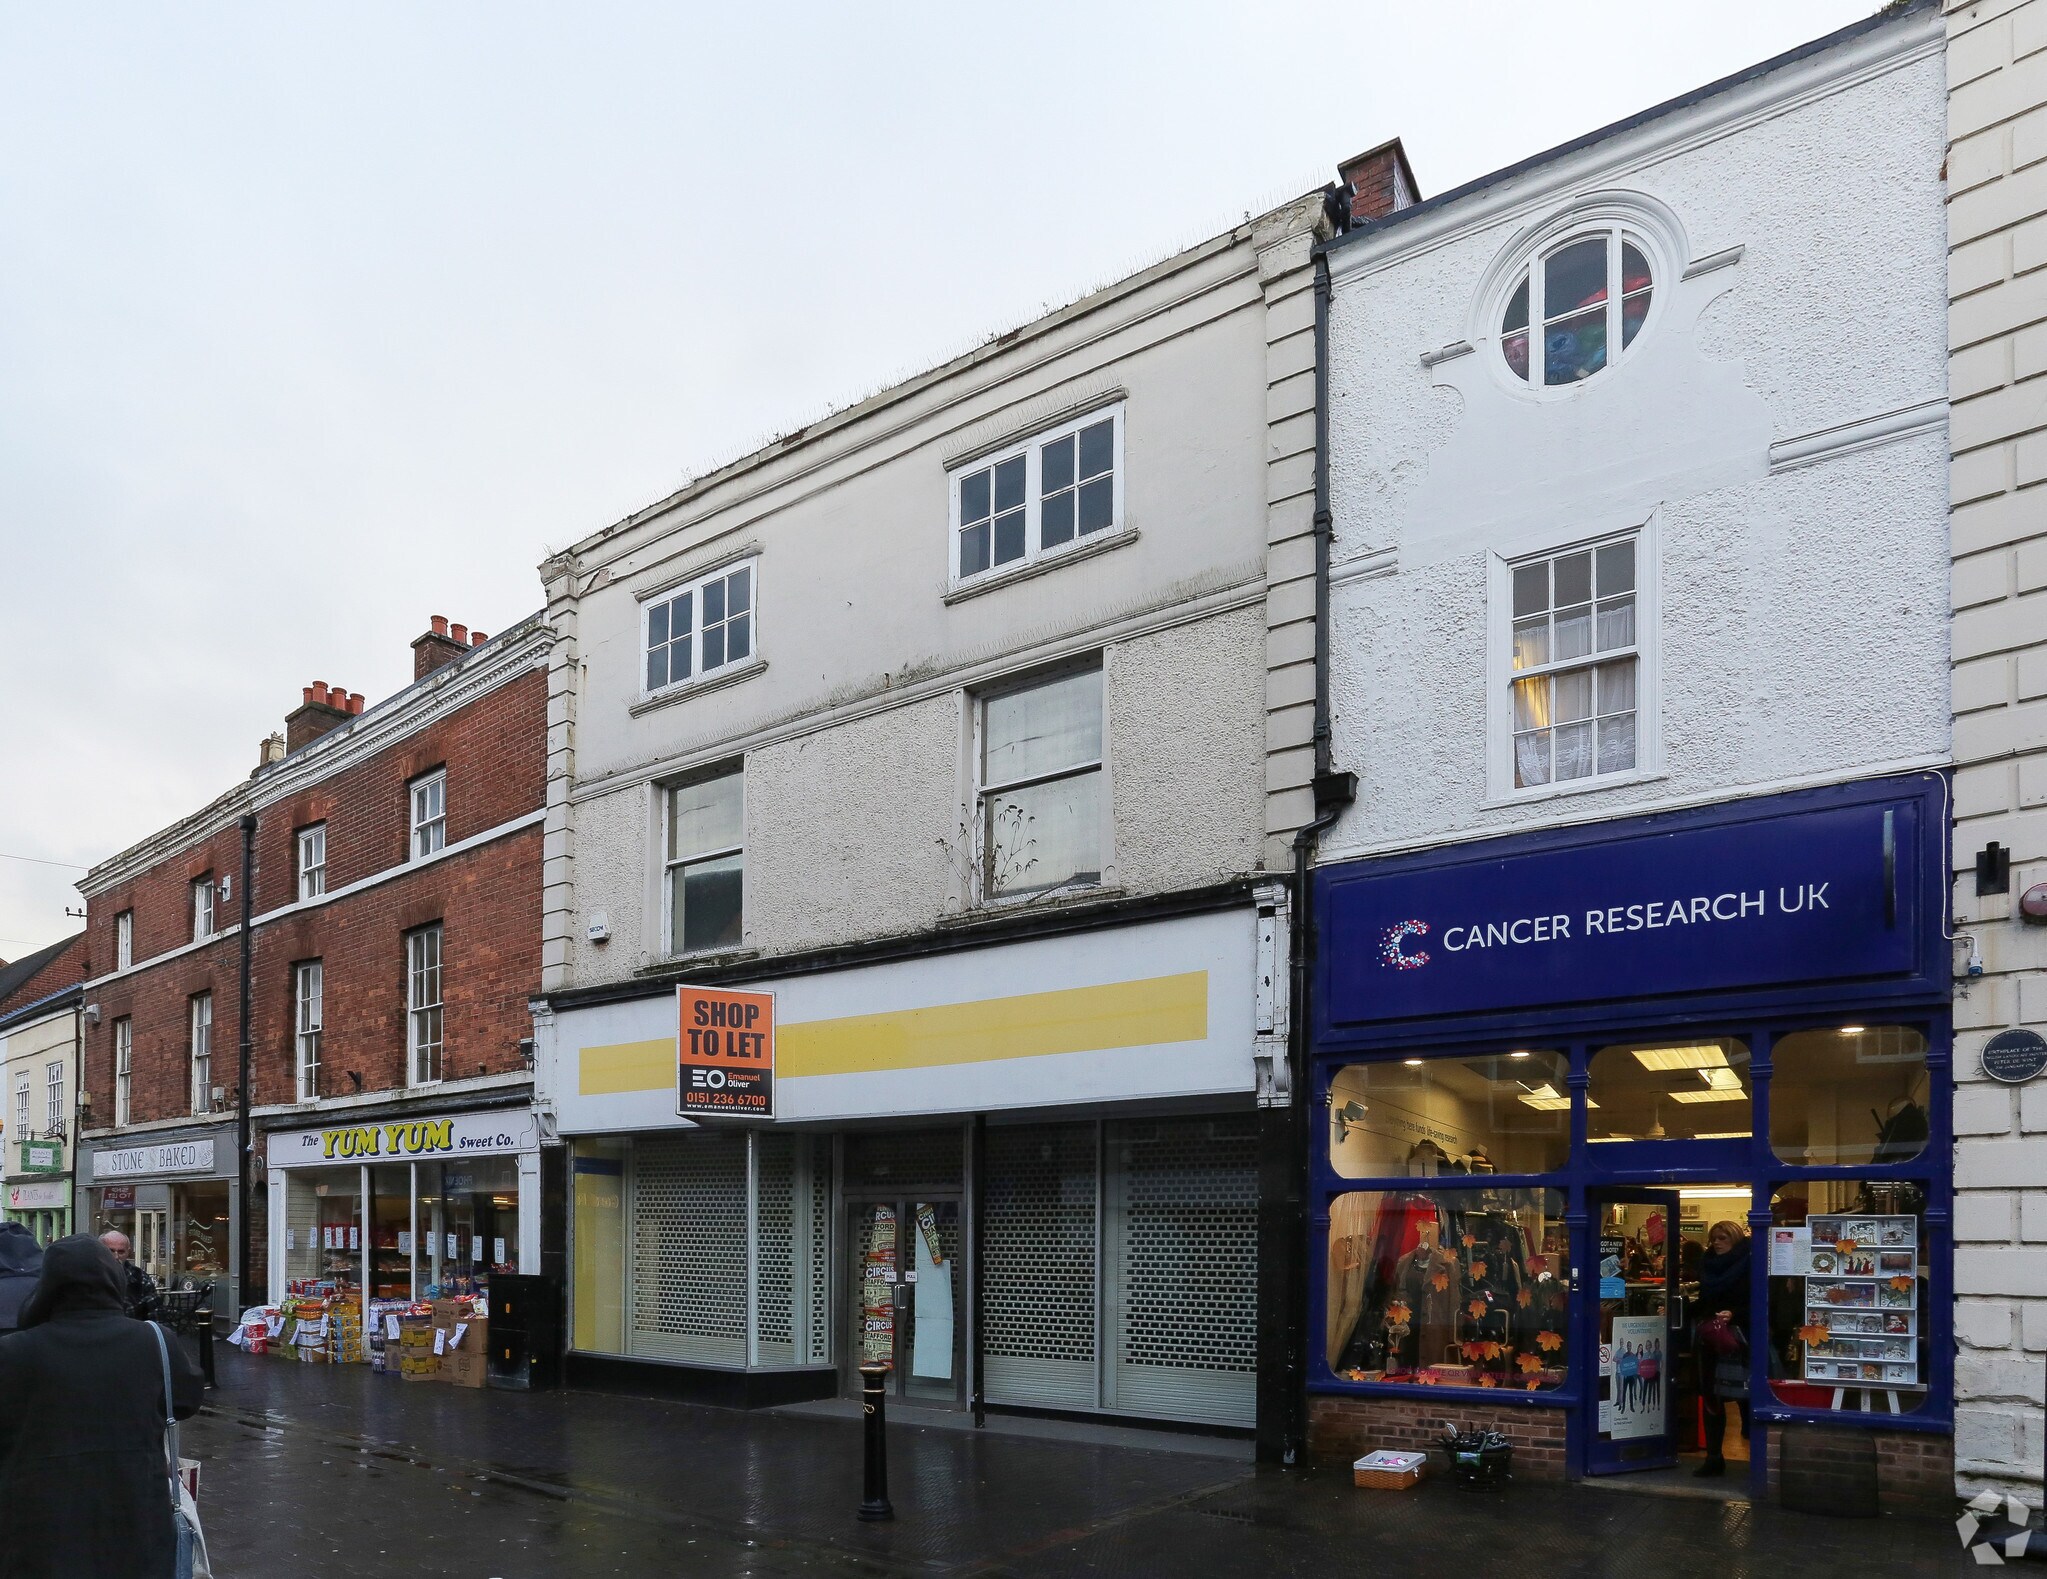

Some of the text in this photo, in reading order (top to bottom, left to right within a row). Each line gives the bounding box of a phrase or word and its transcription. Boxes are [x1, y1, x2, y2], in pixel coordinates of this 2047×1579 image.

[1443, 882, 1830, 952] CANCER RESEARCH UK
[693, 999, 759, 1029] SHOP
[687, 1028, 766, 1059] TO LET
[727, 1072, 761, 1081] Emanuel
[727, 1079, 750, 1088] Oliver
[686, 1092, 766, 1106] 0151 236 6700
[686, 1103, 766, 1112] www.emanueloliver.com
[301, 1119, 514, 1158] The YUM YUM Sweet Co.
[111, 1145, 196, 1171] STONE BAKED
[865, 1320, 893, 1331] CIRCUS
[865, 1332, 892, 1340] STAFFORD
